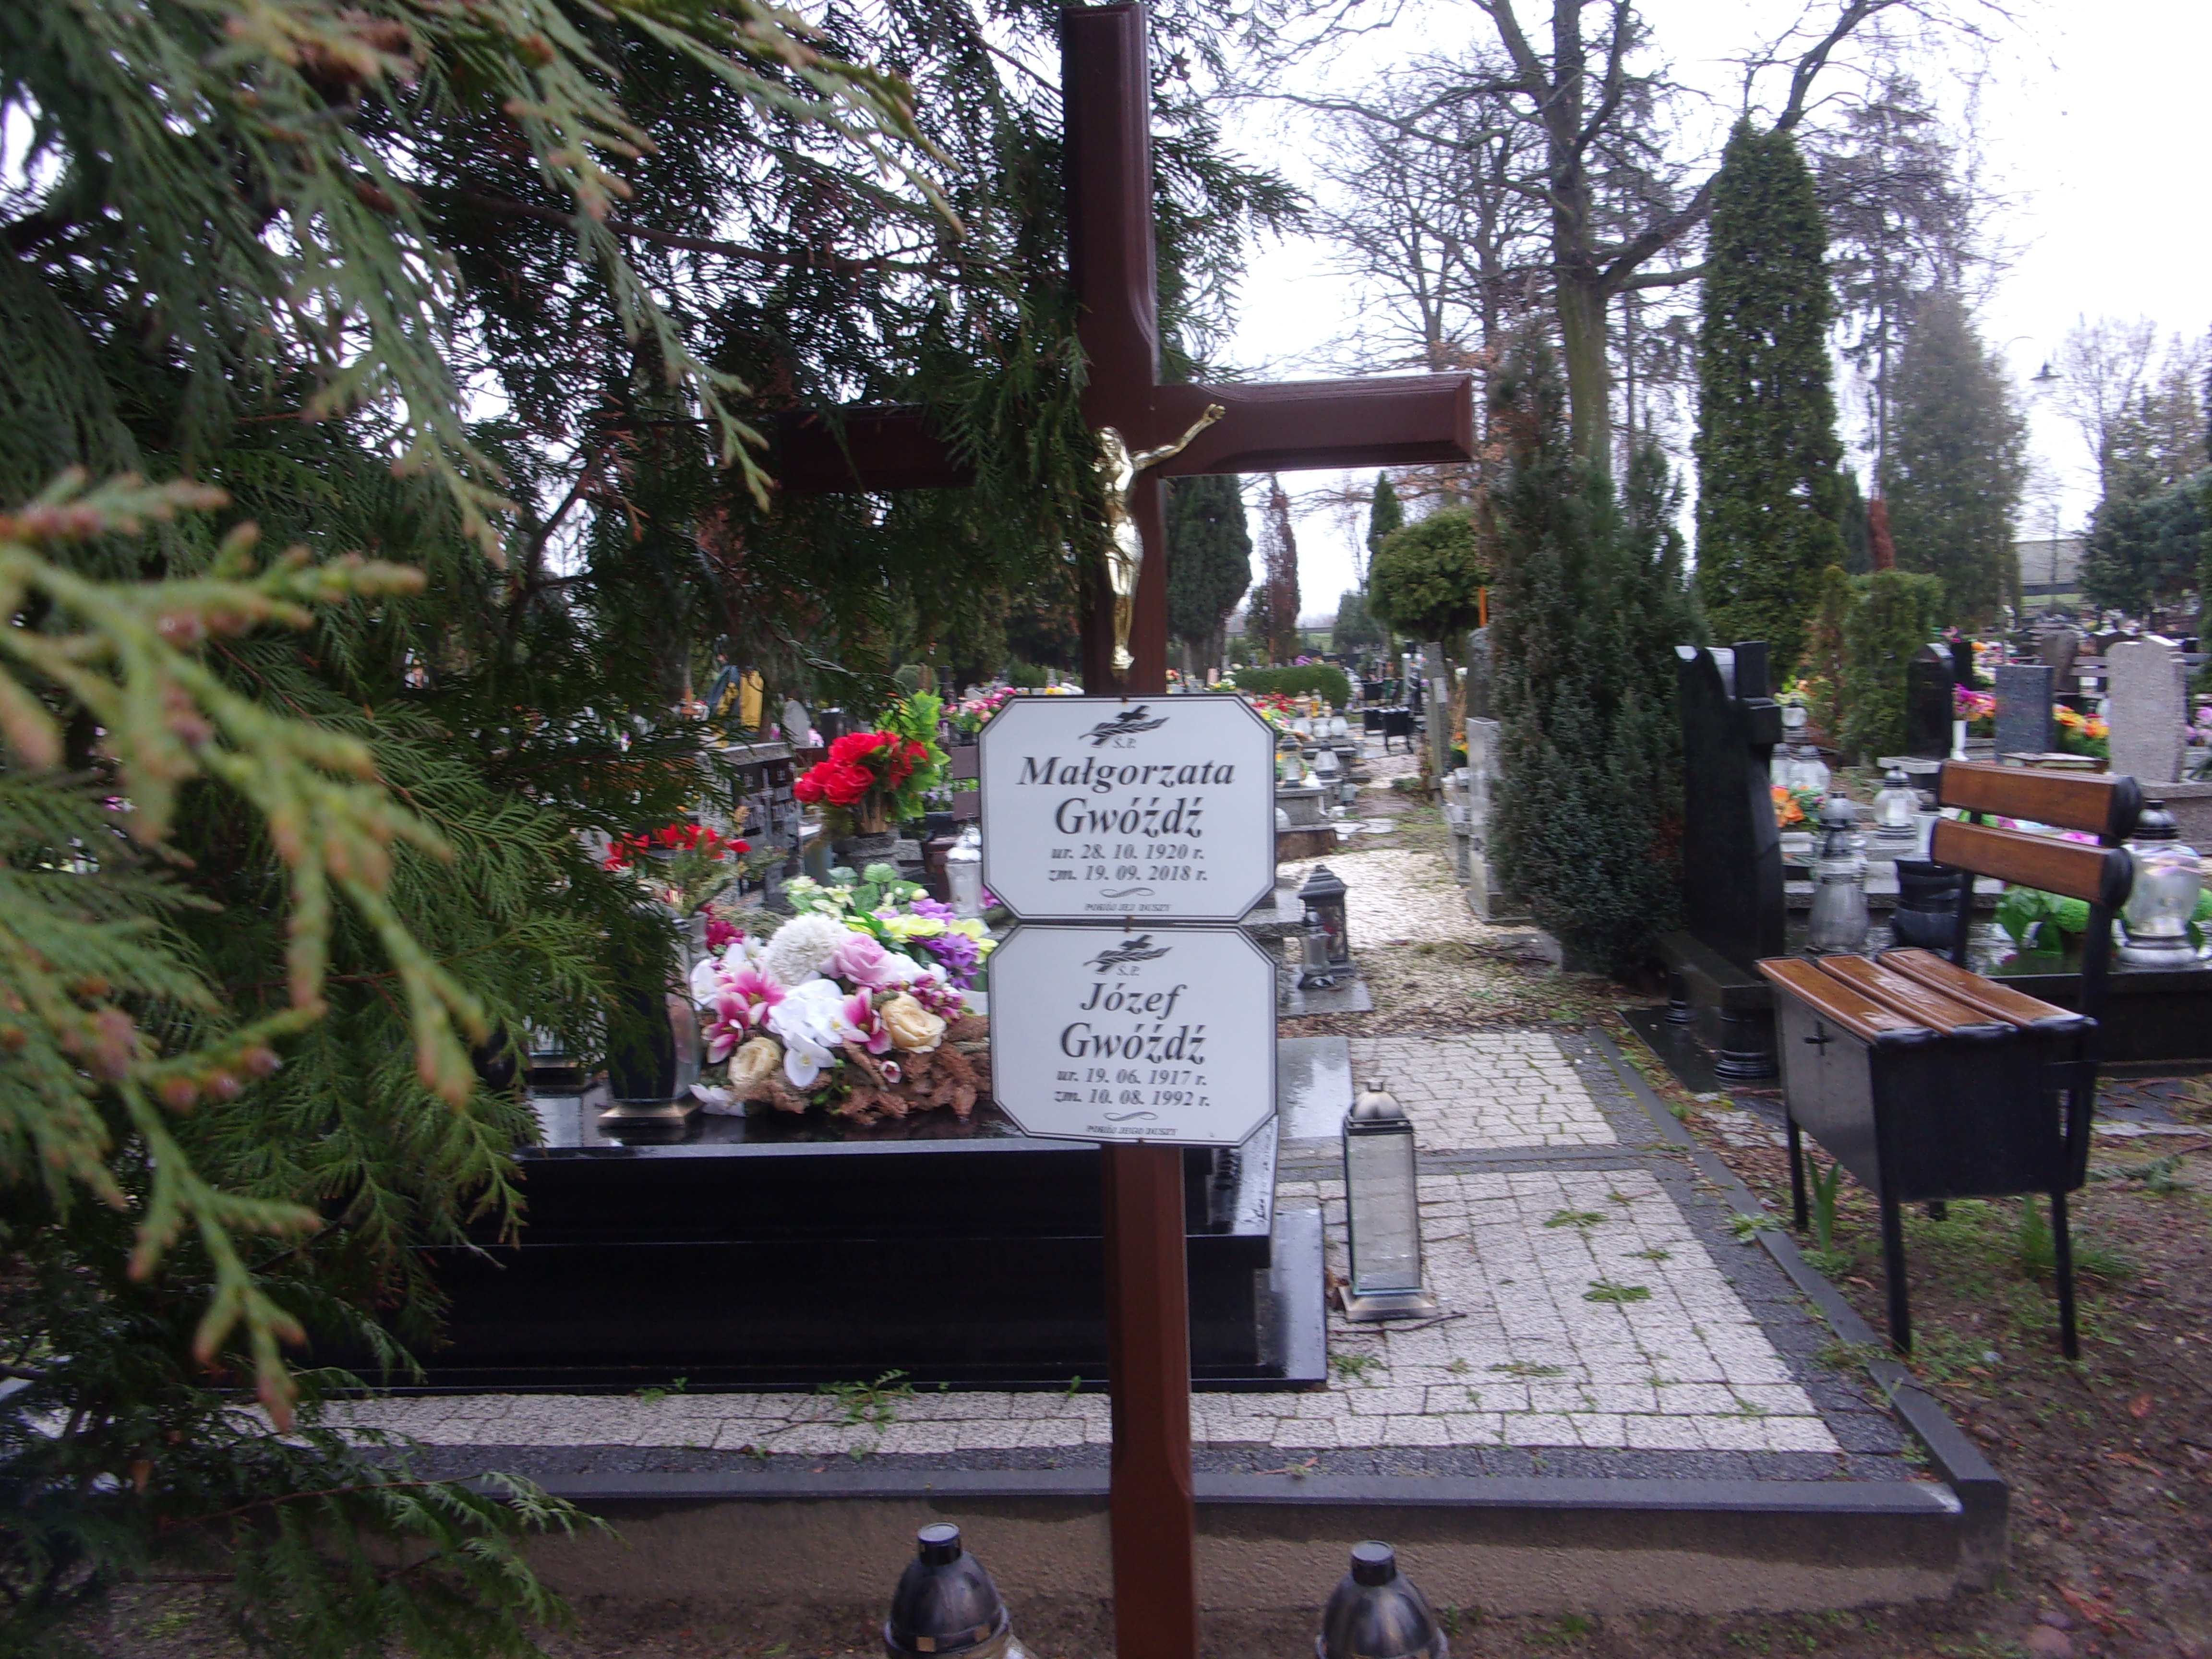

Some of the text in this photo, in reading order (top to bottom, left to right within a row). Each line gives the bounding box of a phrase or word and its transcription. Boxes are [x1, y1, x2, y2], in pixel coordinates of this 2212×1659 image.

[1015, 756, 1235, 793] Małgorzata
[1055, 796, 1204, 838] Gwóźdź
[1050, 848, 1074, 859] ur.
[1145, 844, 1189, 859] 1920
[1048, 870, 1077, 881] zm.
[1147, 865, 1191, 881] 2018
[1080, 982, 1188, 1021] Józef
[1059, 1022, 1206, 1065] Gwóźdź
[1057, 1070, 1079, 1082] ur.
[1148, 1070, 1192, 1085] 1917
[1054, 1091, 1082, 1103] zm.
[1152, 1091, 1194, 1106] 1992
